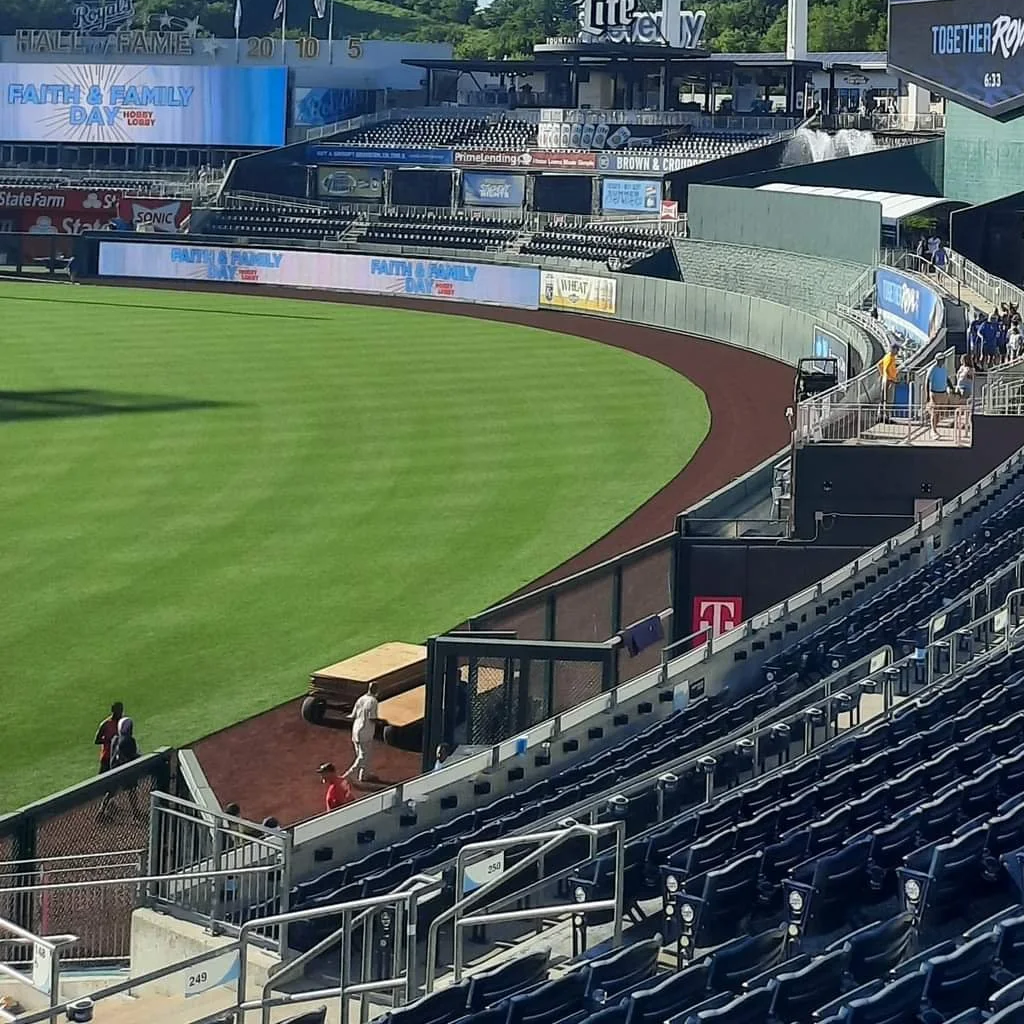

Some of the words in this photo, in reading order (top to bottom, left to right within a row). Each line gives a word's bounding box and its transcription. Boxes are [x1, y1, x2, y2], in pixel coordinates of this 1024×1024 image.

[16, 29, 84, 54] HALL
[116, 30, 193, 55] FAME
[931, 22, 992, 55] TOGETHER
[247, 37, 274, 57] 20
[296, 37, 319, 58] 10
[347, 36, 363, 58] 5
[984, 72, 1001, 87] 6:33
[8, 83, 80, 105] FAITH
[86, 85, 103, 105] &
[109, 85, 195, 107] FAMILY
[69, 106, 120, 126] DAY
[123, 111, 153, 119] HOBBY
[127, 118, 155, 126] LOBBY
[455, 153, 516, 165] PrimeLending
[617, 157, 649, 170] BROWN
[652, 157, 660, 170] &
[136, 212, 173, 223] SONIC
[171, 248, 215, 263] FAITH
[231, 250, 283, 268] FAMILY
[207, 265, 238, 280] DAY
[371, 259, 412, 276] FAITH
[430, 263, 476, 281] FAMILY
[405, 277, 433, 293] DAY
[561, 279, 588, 295] WHEAT
[488, 862, 501, 874] 250
[188, 972, 208, 987] 249
